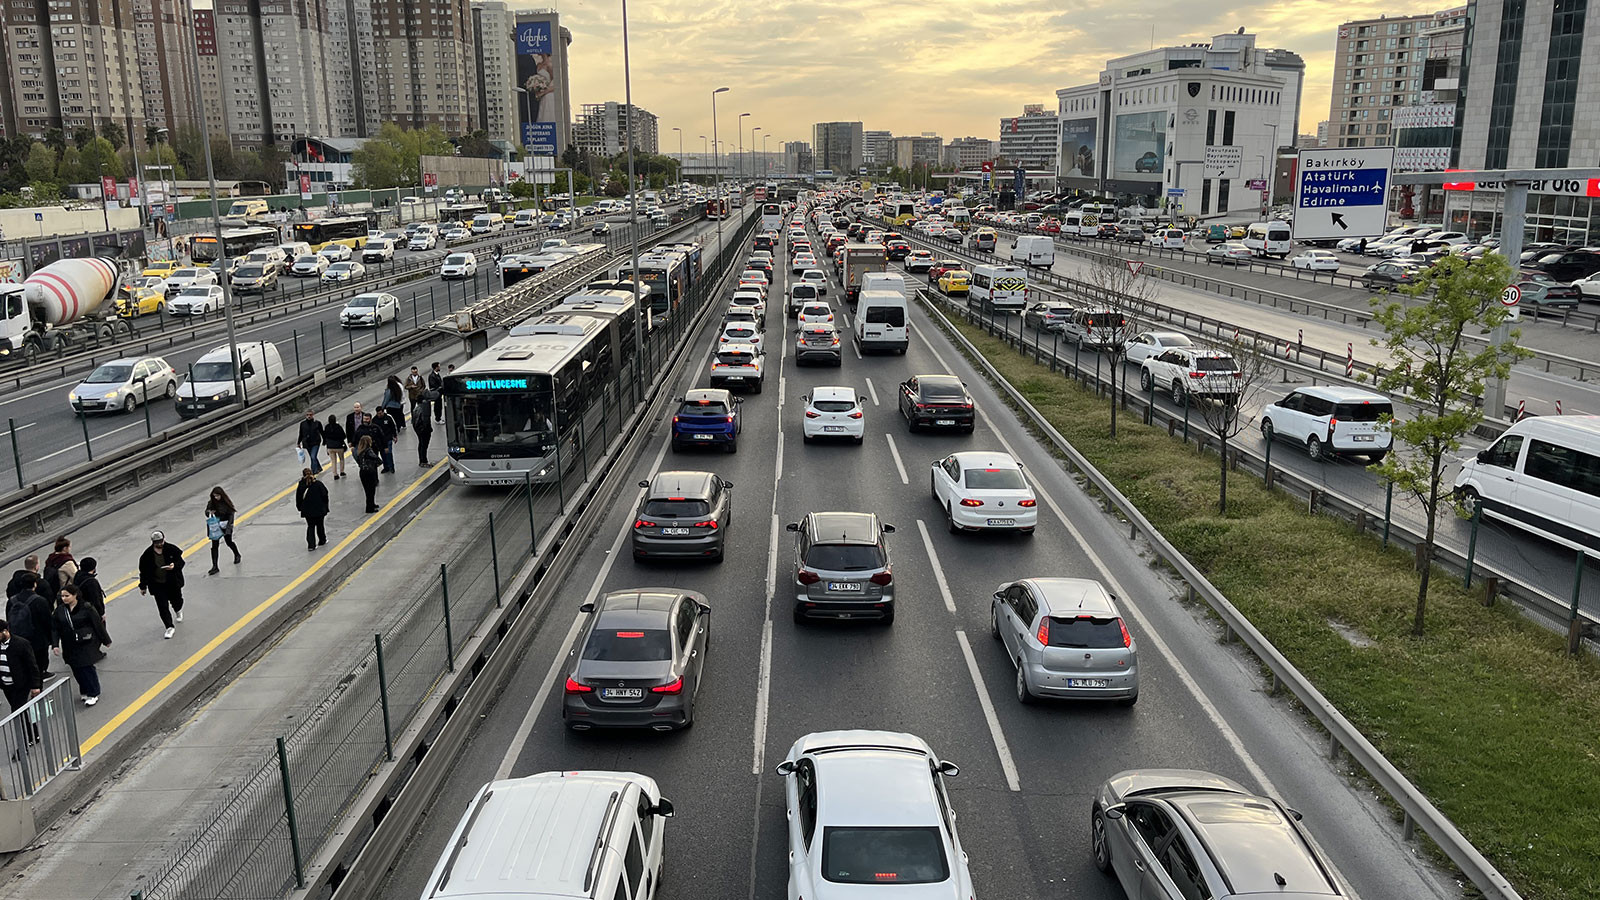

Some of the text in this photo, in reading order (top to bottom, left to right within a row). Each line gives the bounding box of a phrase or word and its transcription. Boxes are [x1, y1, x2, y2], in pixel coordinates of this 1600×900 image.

[1306, 158, 1364, 168] Bakırköy
[1304, 171, 1354, 181] Atatürk
[1304, 184, 1370, 194] Havalimanı
[1552, 178, 1580, 192] Oto
[1302, 197, 1346, 206] Edirne
[1503, 290, 1516, 300] 90
